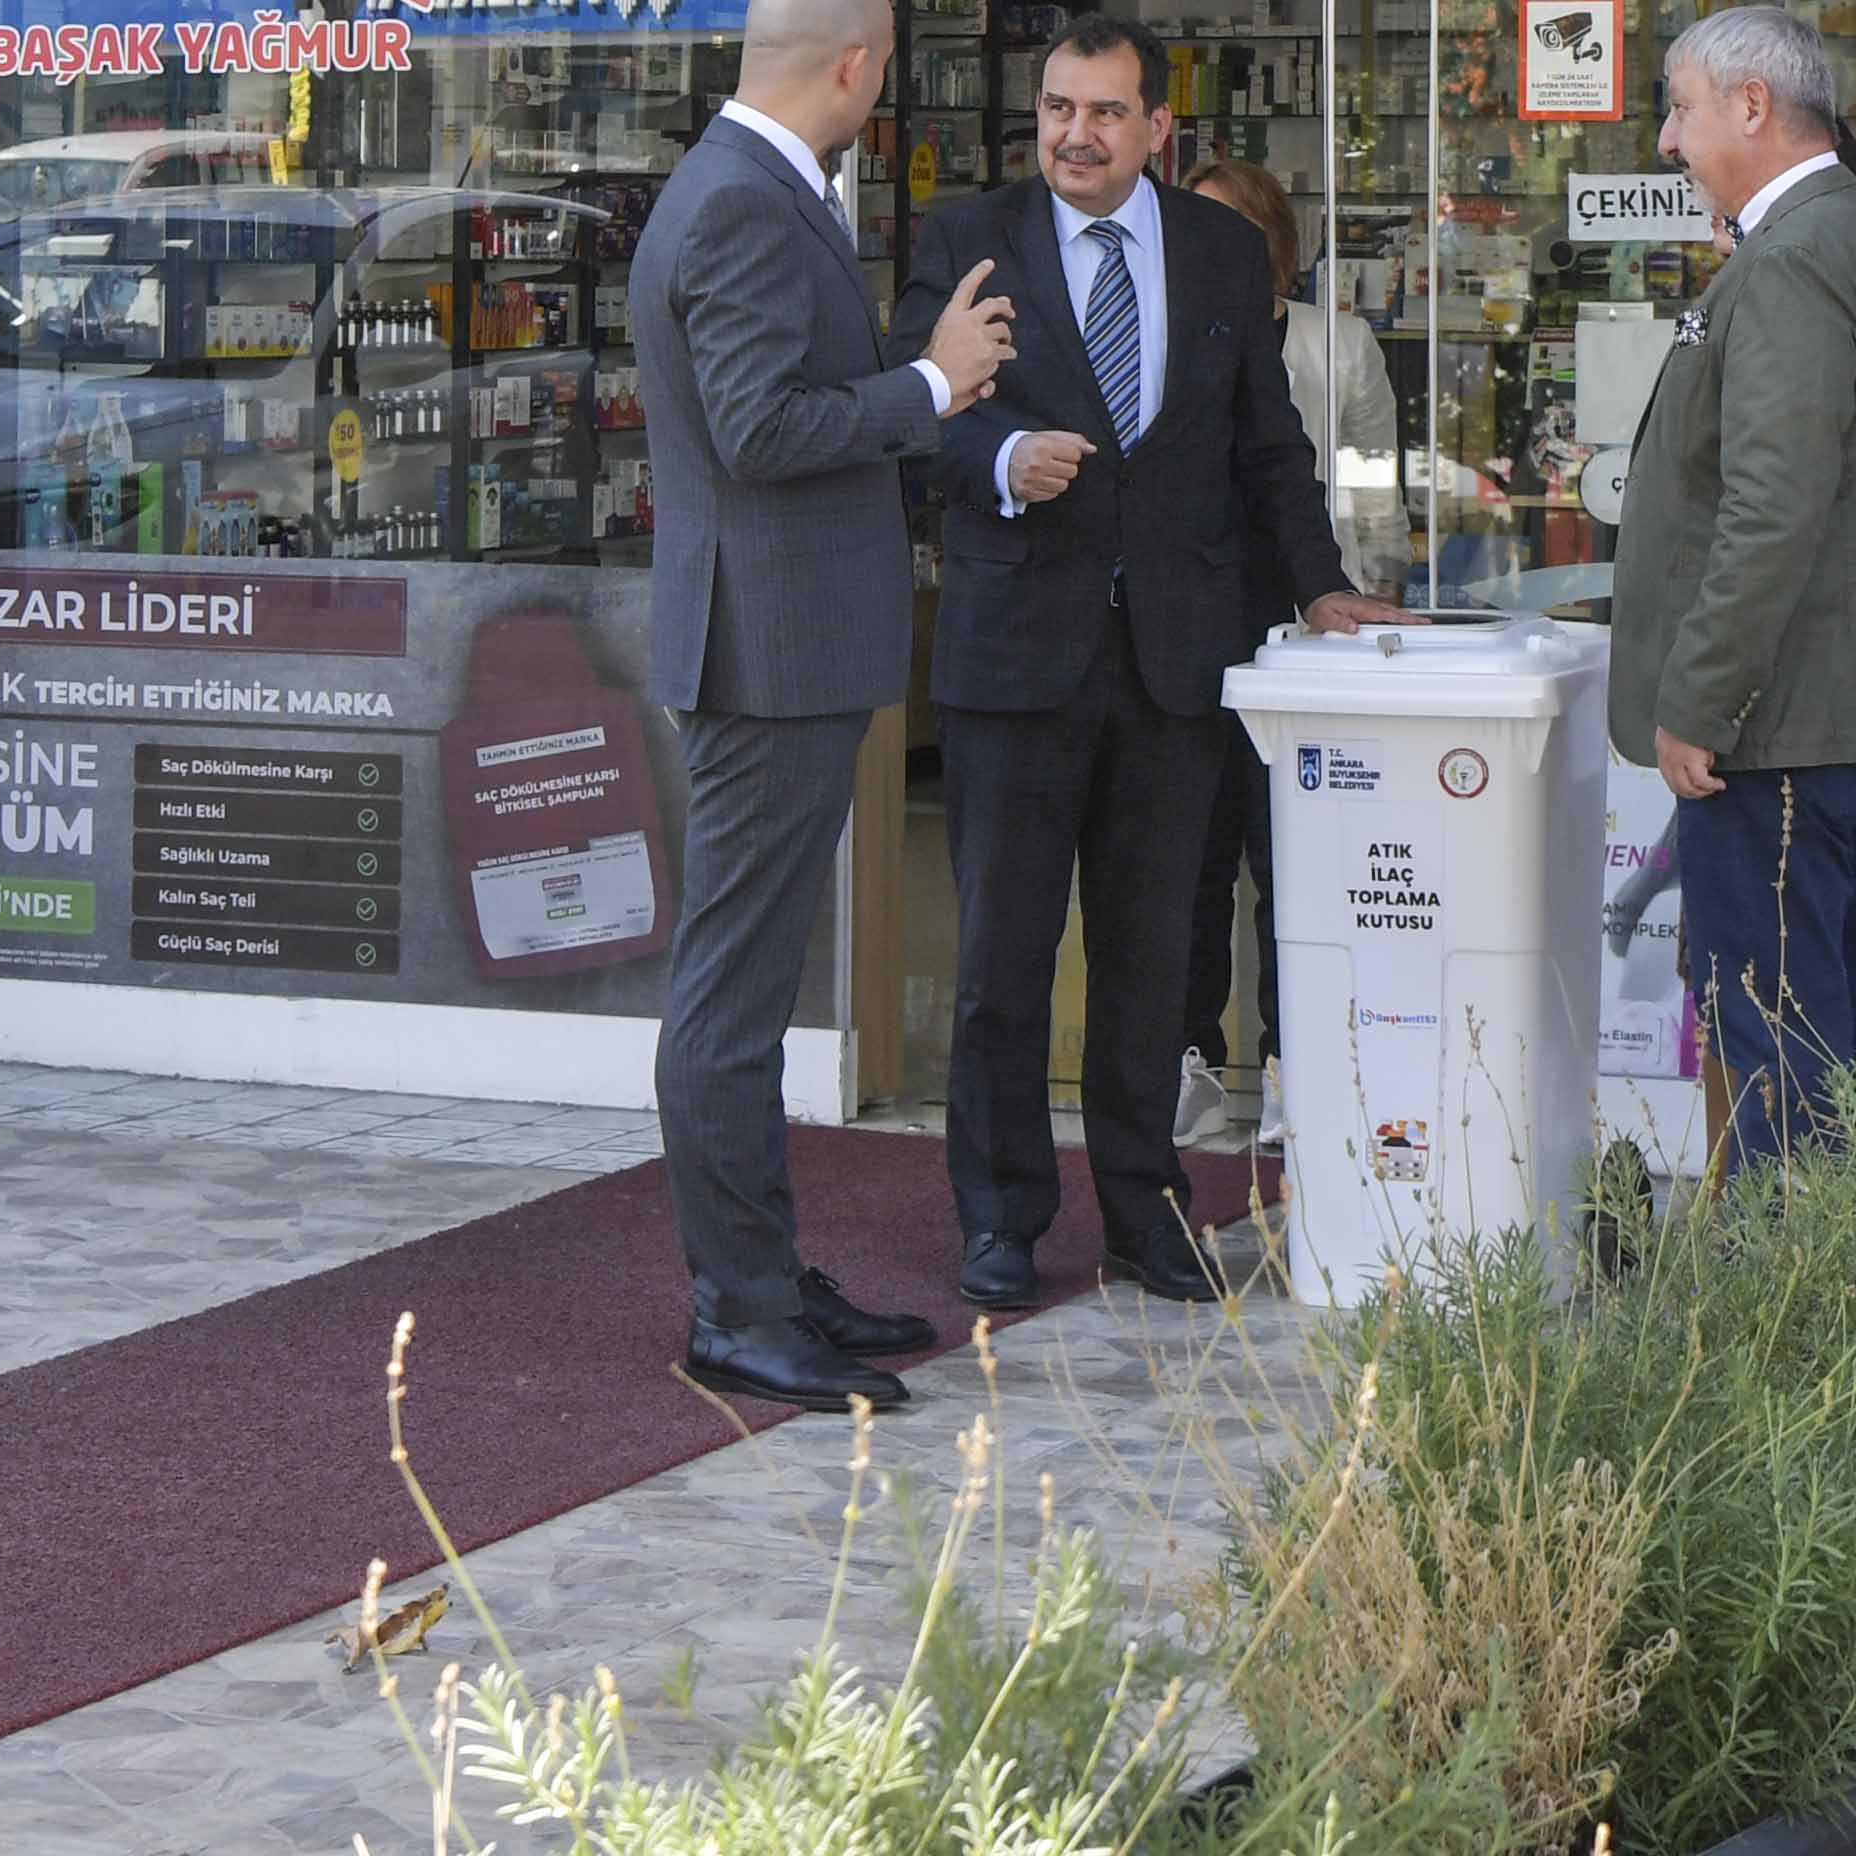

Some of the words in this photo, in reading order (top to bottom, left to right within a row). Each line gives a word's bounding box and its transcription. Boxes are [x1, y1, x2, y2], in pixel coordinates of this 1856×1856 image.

[174, 10, 412, 74] YAĞMUR
[34, 675, 135, 707] TERCİH
[143, 678, 280, 713] ETTİĞİNİZ
[287, 689, 394, 718] MARKA
[481, 747, 517, 762] TAHMİN
[566, 732, 601, 748] MARKA
[161, 758, 189, 780] Saç
[191, 758, 291, 780] Dökülmesine
[294, 763, 333, 783] Karşı
[1329, 760, 1364, 768] ANKARA
[474, 790, 499, 805] SAÇ
[500, 774, 583, 800] DÖKÜLMESİNE
[584, 768, 620, 785] KARŞI
[160, 801, 192, 820] Hızlı
[194, 802, 226, 820] Etki
[494, 798, 546, 815] BİTKİSEL
[547, 786, 605, 808] ŞAMPUAN
[160, 846, 214, 868] Sağlıklı
[218, 850, 271, 867] Uzama
[1368, 843, 1412, 859] ATIK
[1370, 863, 1414, 888] İLAÇ
[158, 889, 196, 908] Kalın
[200, 892, 226, 913] Saç
[229, 892, 256, 909] Teli
[1347, 889, 1441, 906] TOPLAMA
[1356, 911, 1433, 931] KUTUSU
[158, 934, 202, 955] Güçlü
[206, 937, 232, 957] Saç
[236, 938, 280, 956] Derisi
